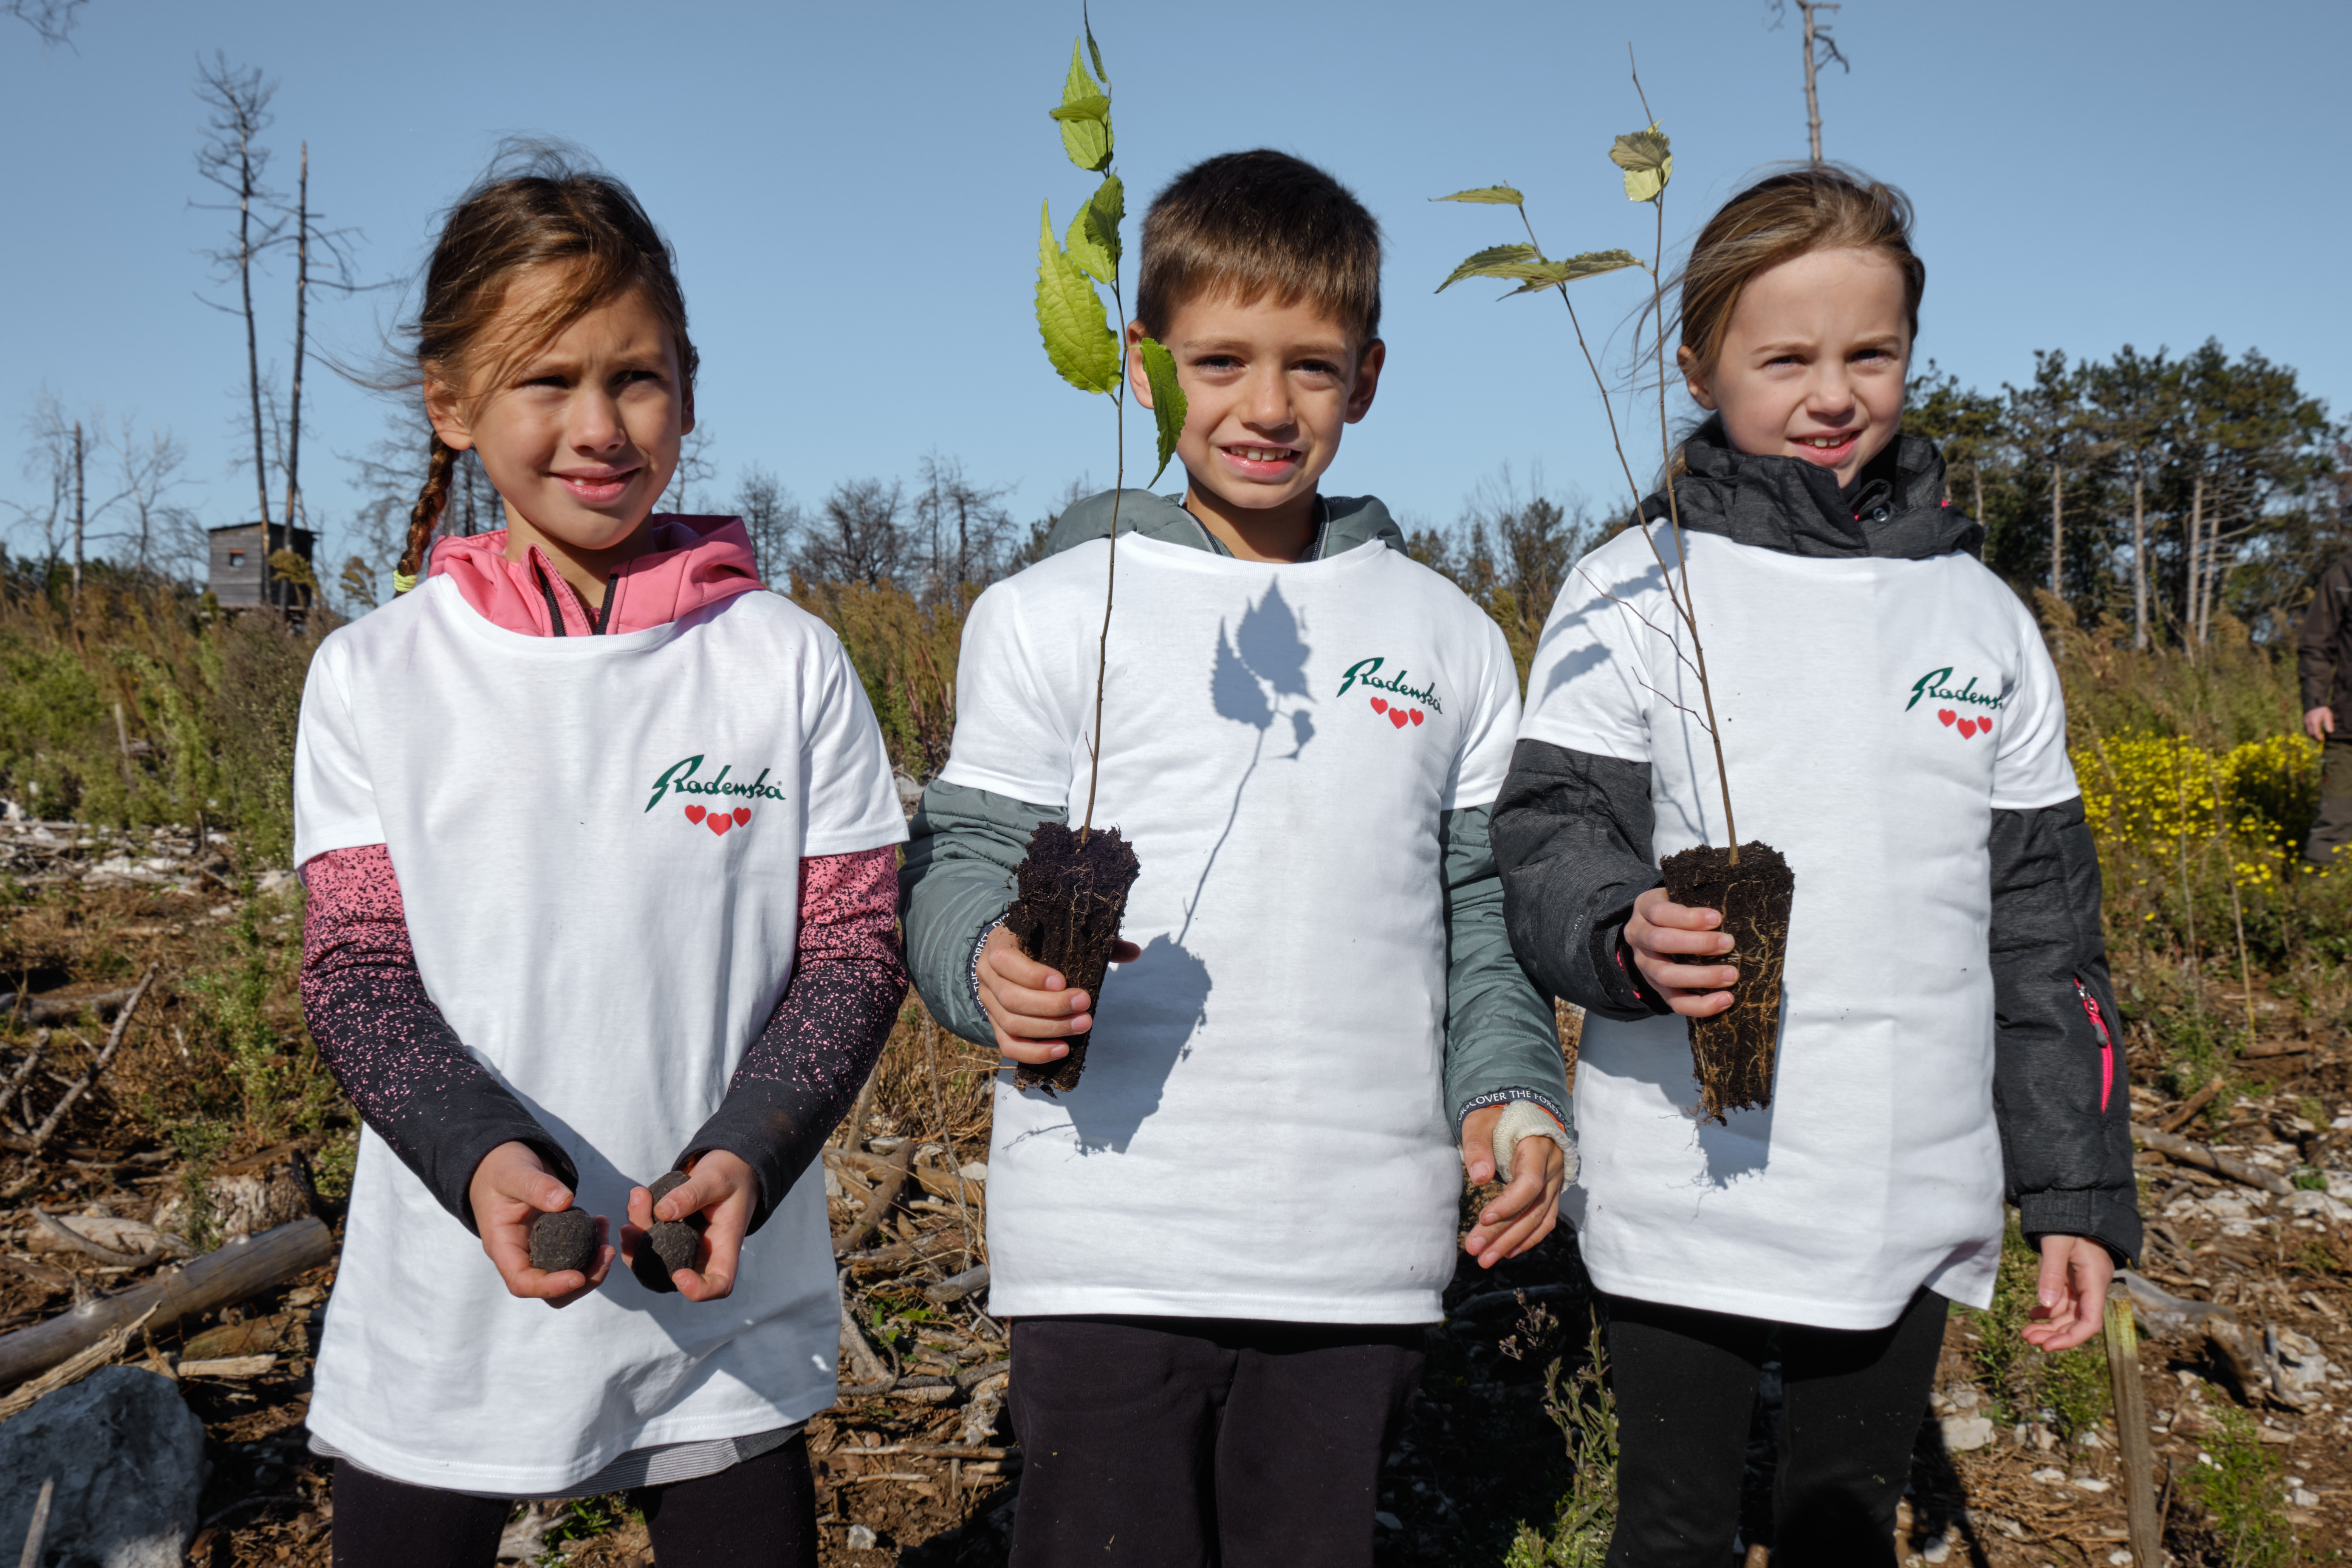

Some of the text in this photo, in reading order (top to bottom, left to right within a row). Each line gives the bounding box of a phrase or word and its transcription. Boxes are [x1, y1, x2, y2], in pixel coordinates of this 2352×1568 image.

[1336, 657, 1443, 714] Radenska
[1905, 666, 2002, 713] Radens
[644, 754, 786, 813] Radenska
[1509, 1090, 1531, 1099] THE
